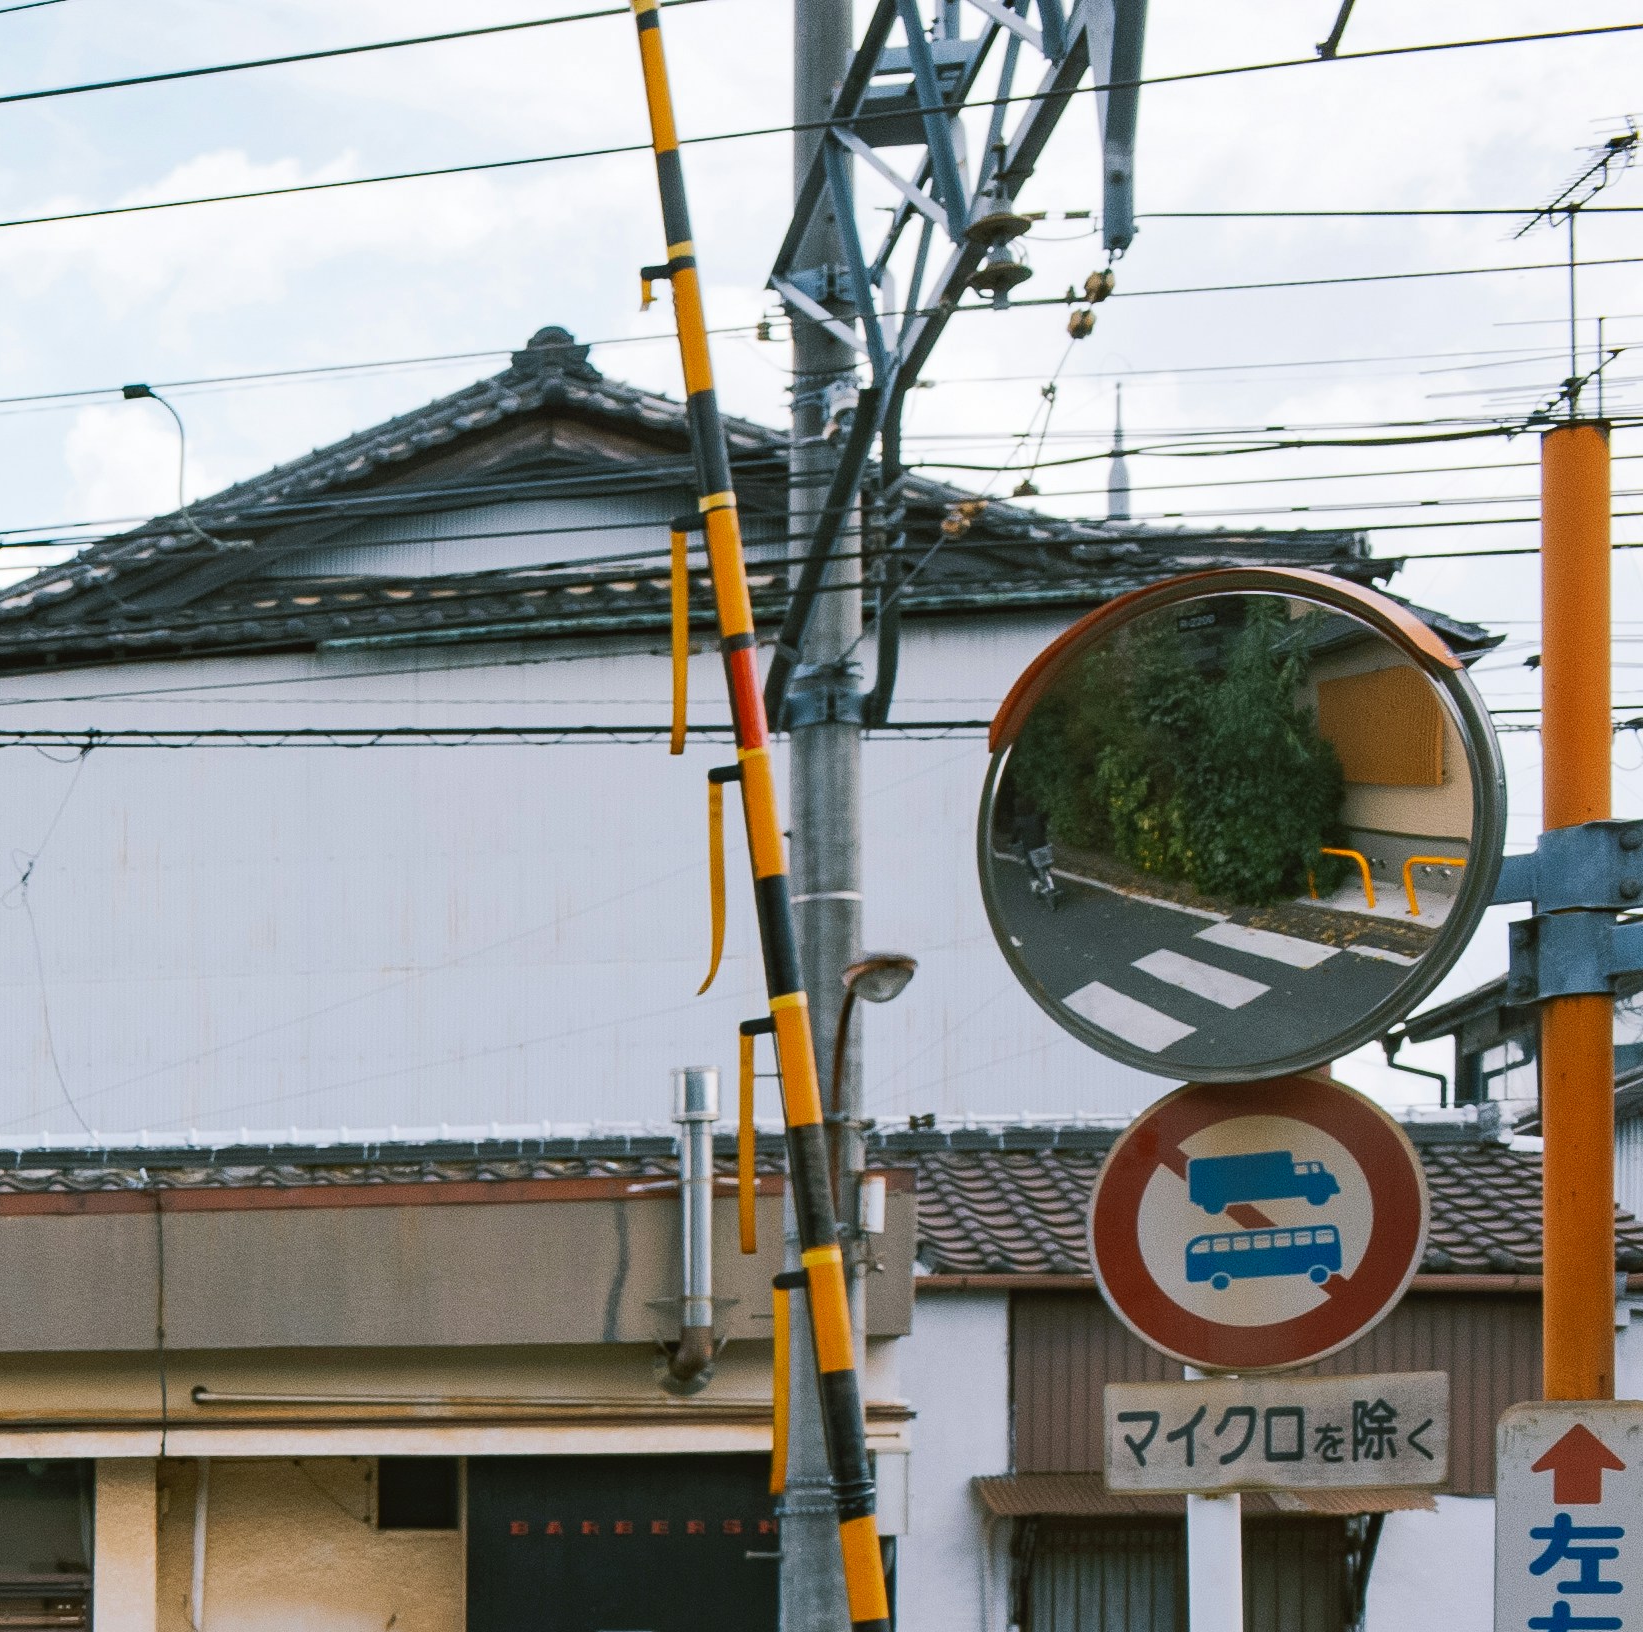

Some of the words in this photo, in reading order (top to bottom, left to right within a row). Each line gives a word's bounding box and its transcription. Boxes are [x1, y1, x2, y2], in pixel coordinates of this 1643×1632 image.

[1117, 1398, 1434, 1467] マイクロを除く
